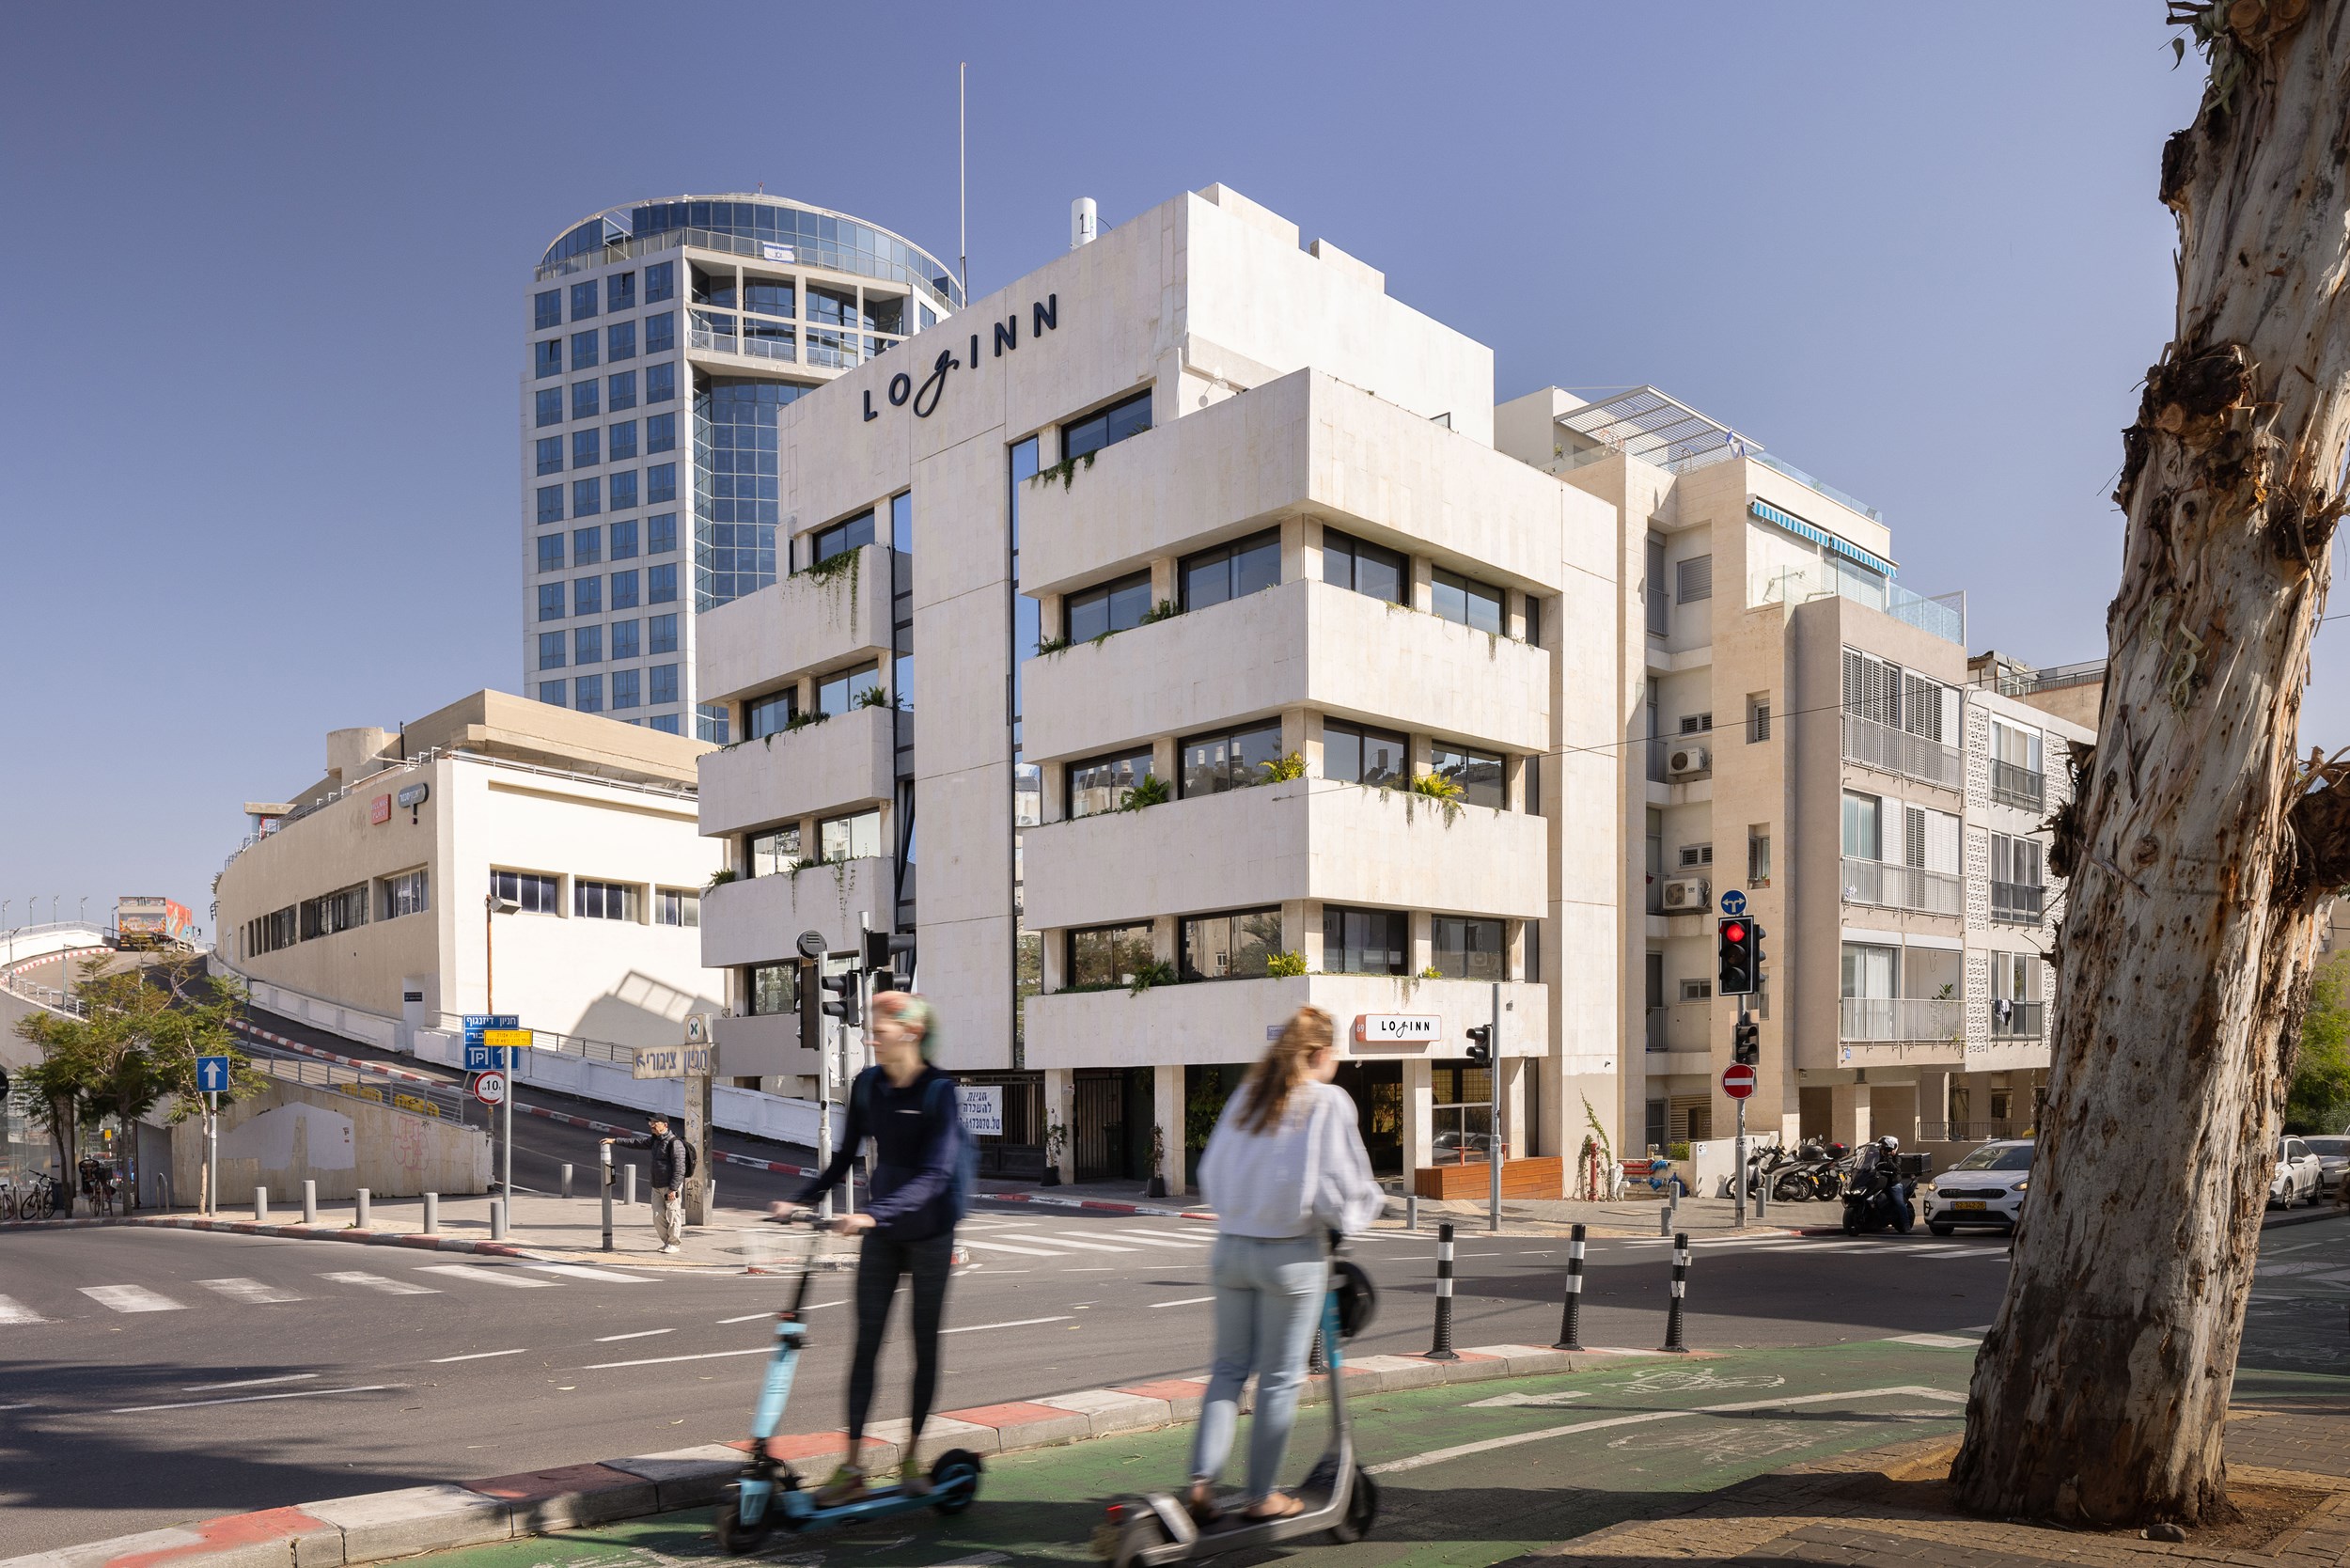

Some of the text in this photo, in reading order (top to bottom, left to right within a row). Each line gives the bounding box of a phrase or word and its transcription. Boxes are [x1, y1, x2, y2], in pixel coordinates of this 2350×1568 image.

[466, 1017, 516, 1027] חניון דיזנגוף
[1356, 1024, 1365, 1033] 69
[476, 1053, 484, 1064] P
[646, 1050, 708, 1074] חניון ציבורי
[487, 1080, 499, 1091] 10
[963, 1101, 993, 1114] להשכרה
